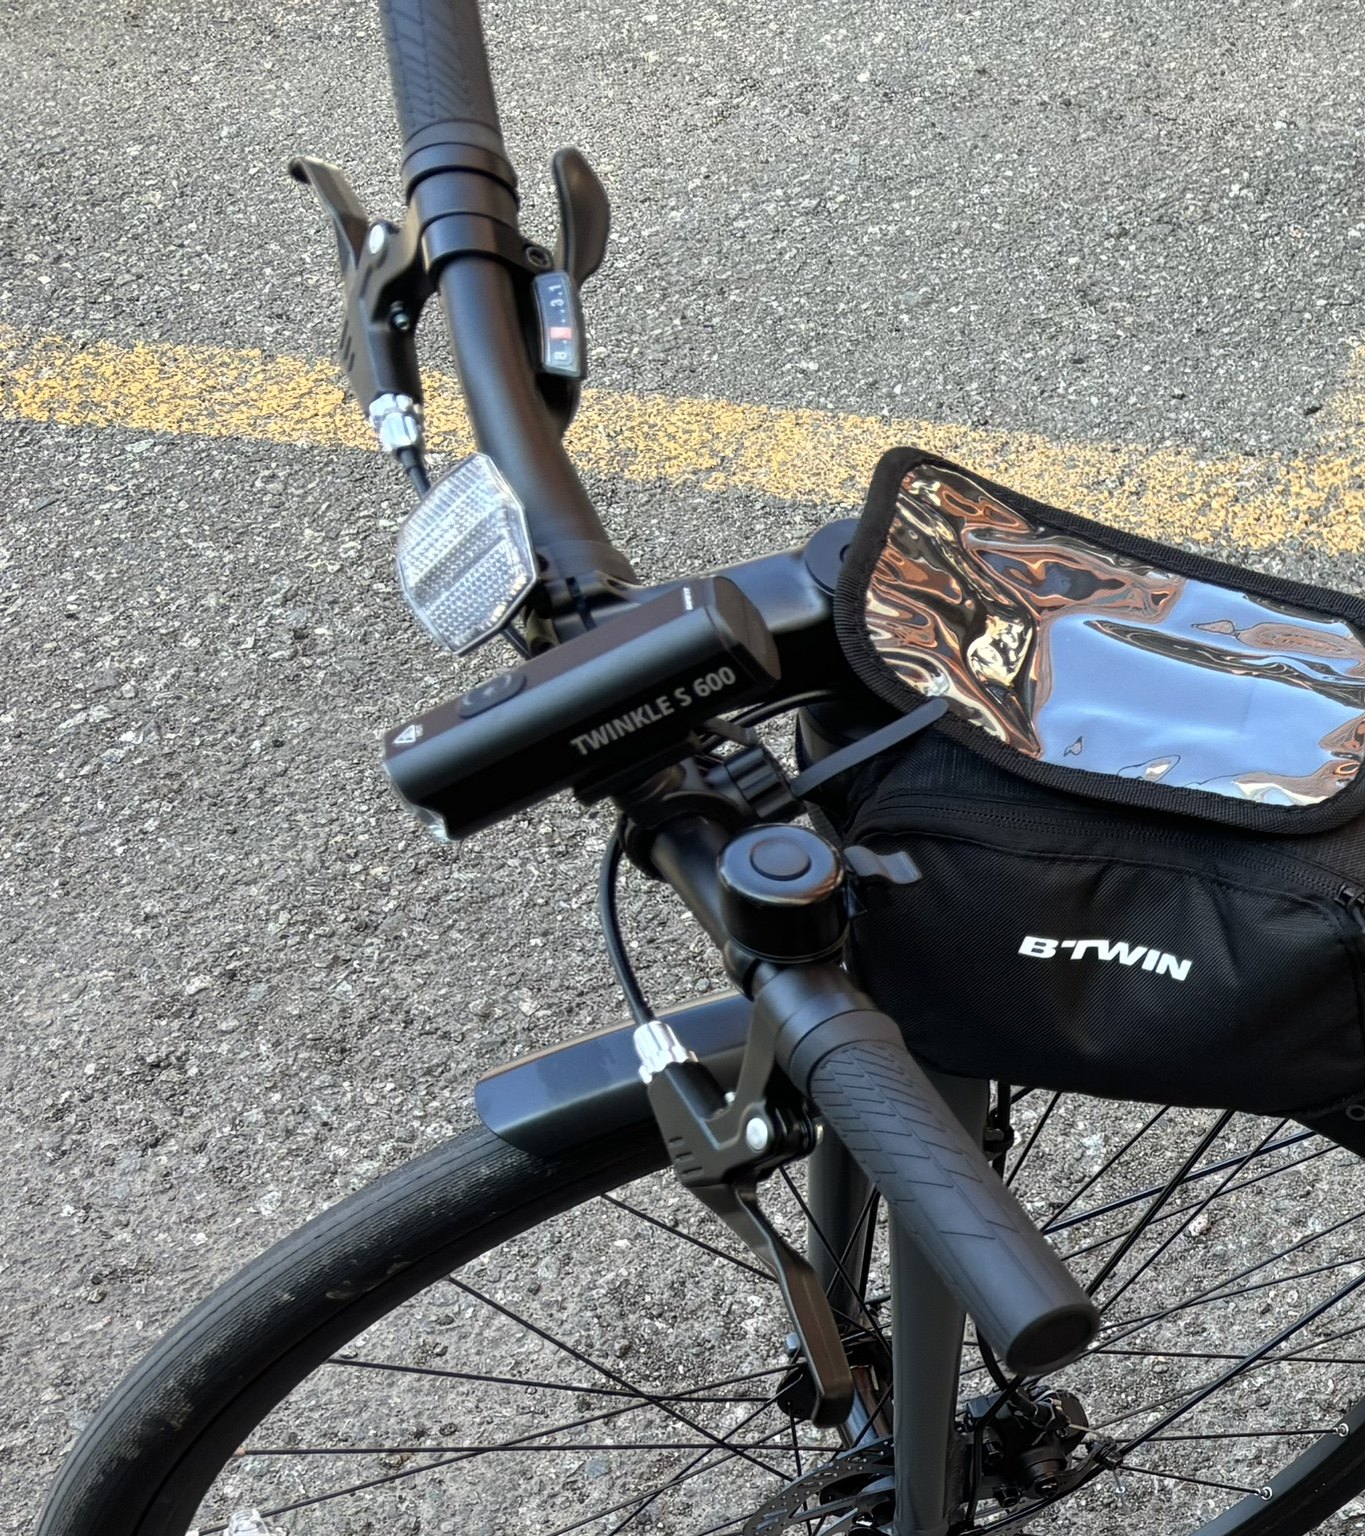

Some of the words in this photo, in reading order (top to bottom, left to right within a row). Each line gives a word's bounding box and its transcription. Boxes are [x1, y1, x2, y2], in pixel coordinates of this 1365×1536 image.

[570, 696, 674, 757] TWINKLE
[673, 685, 693, 709] S
[694, 666, 737, 699] 600
